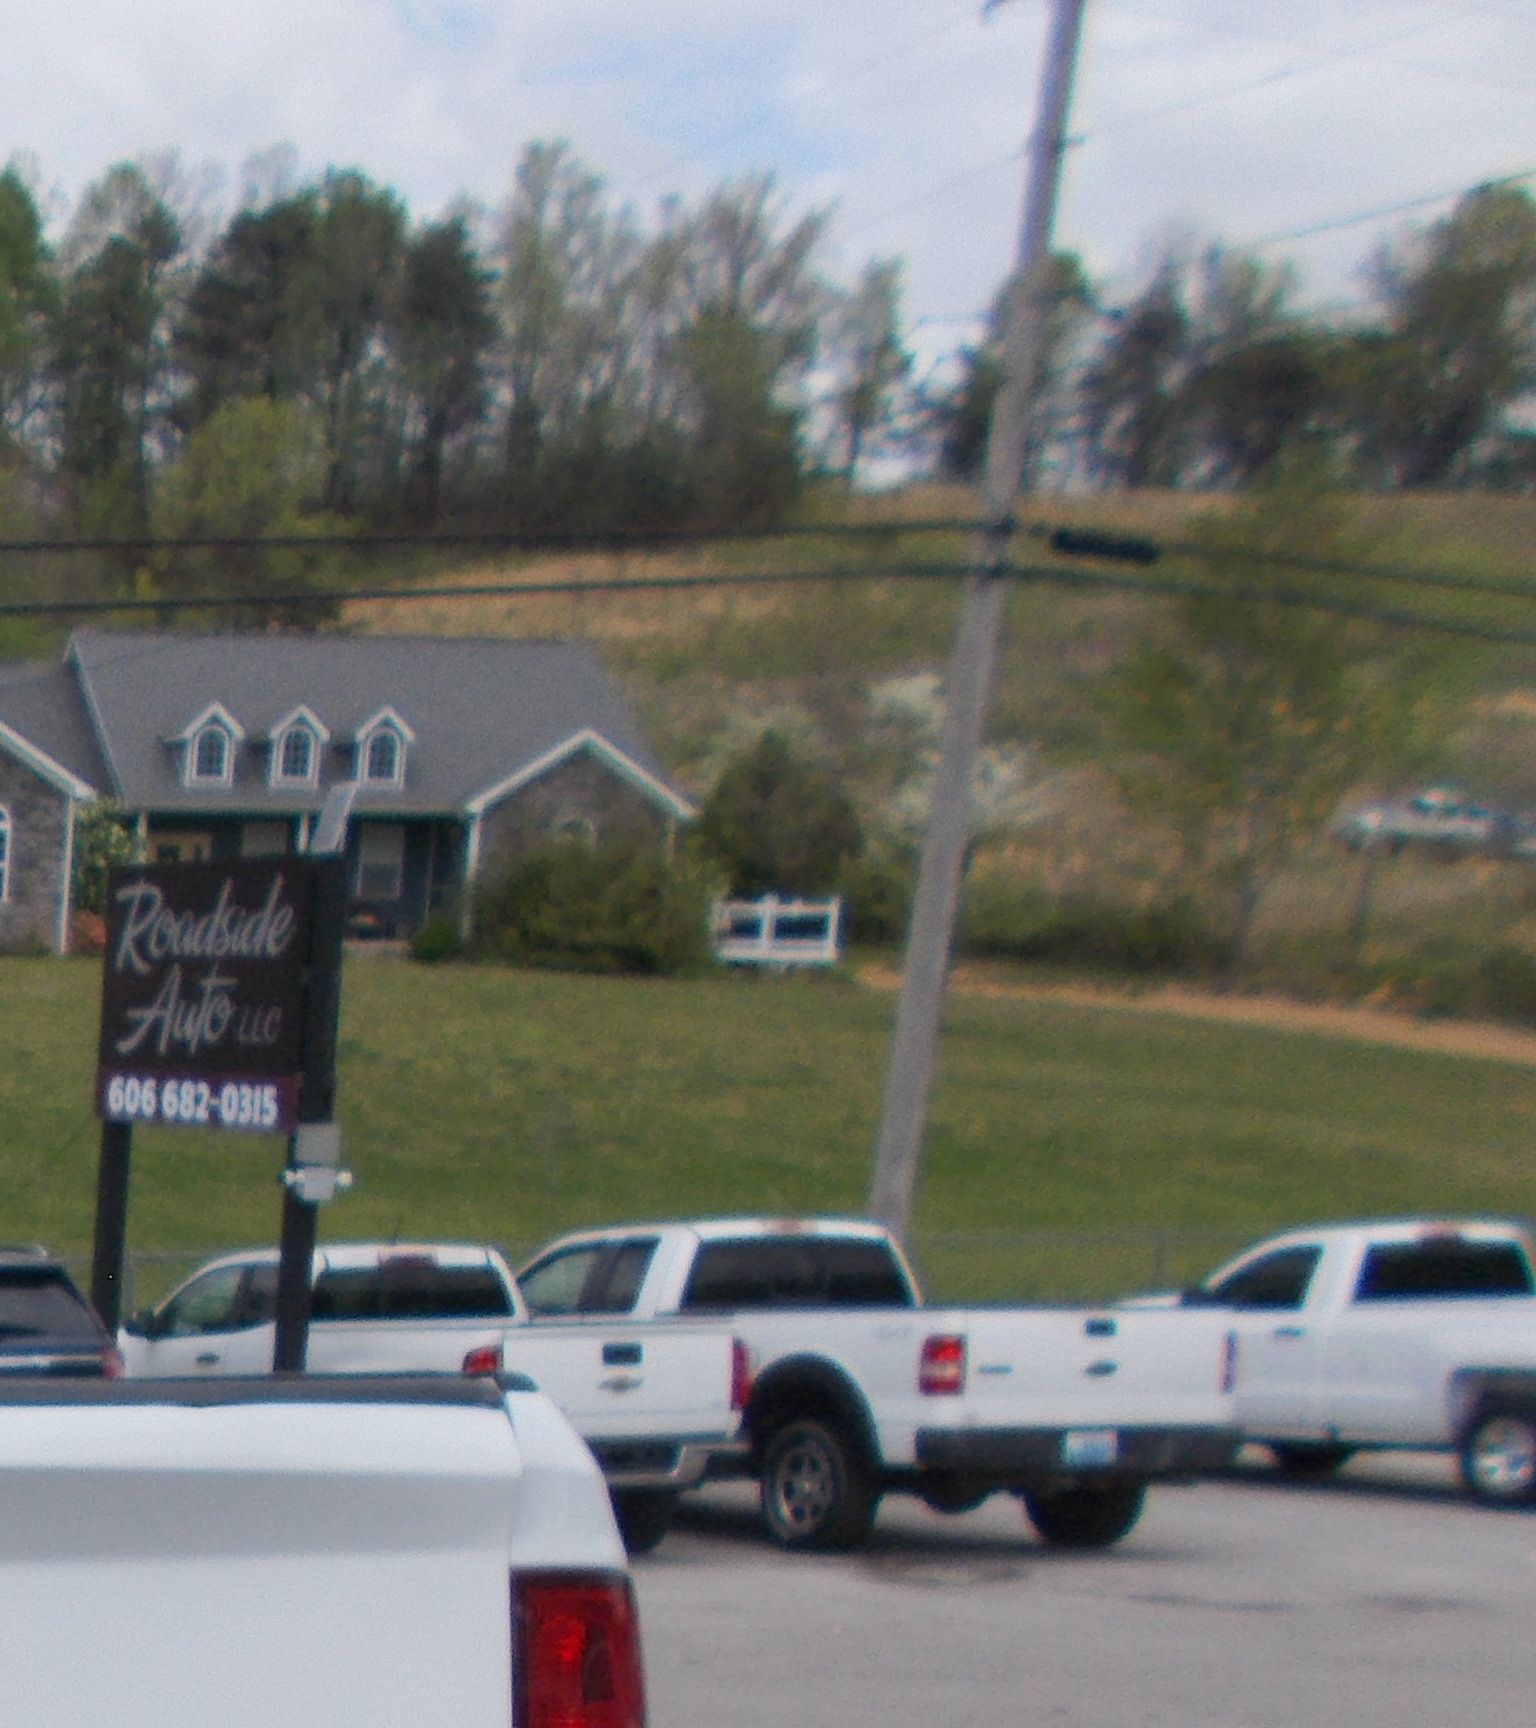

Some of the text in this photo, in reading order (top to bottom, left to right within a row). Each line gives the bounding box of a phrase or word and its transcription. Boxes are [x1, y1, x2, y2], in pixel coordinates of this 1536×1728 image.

[117, 876, 295, 972] Roadside
[117, 962, 237, 1055] Auto
[108, 1075, 277, 1125] 606 682-0315
